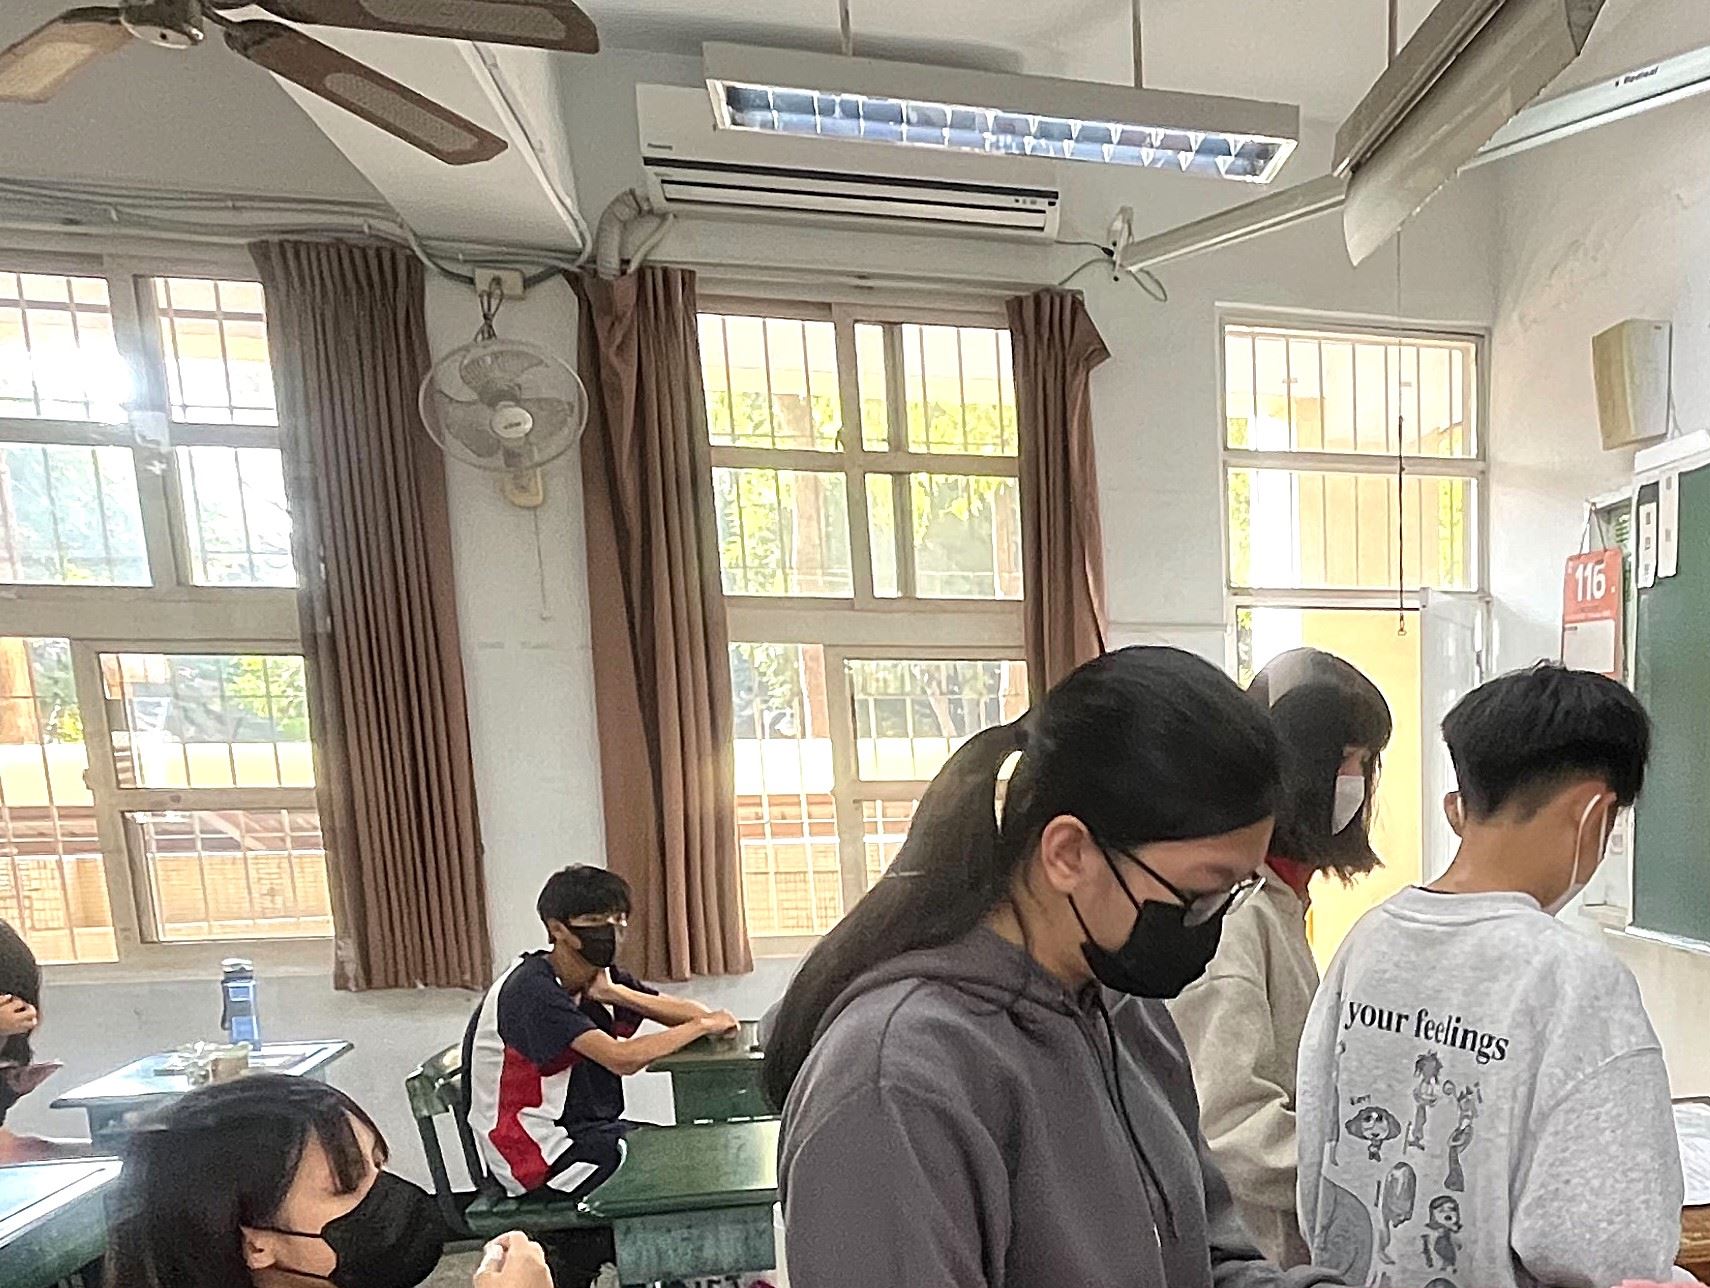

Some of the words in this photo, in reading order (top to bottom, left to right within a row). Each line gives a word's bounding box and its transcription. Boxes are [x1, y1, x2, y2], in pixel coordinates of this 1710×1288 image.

[1575, 561, 1607, 602] 116
[1344, 1001, 1409, 1033] your
[1414, 1007, 1509, 1065] feelings
